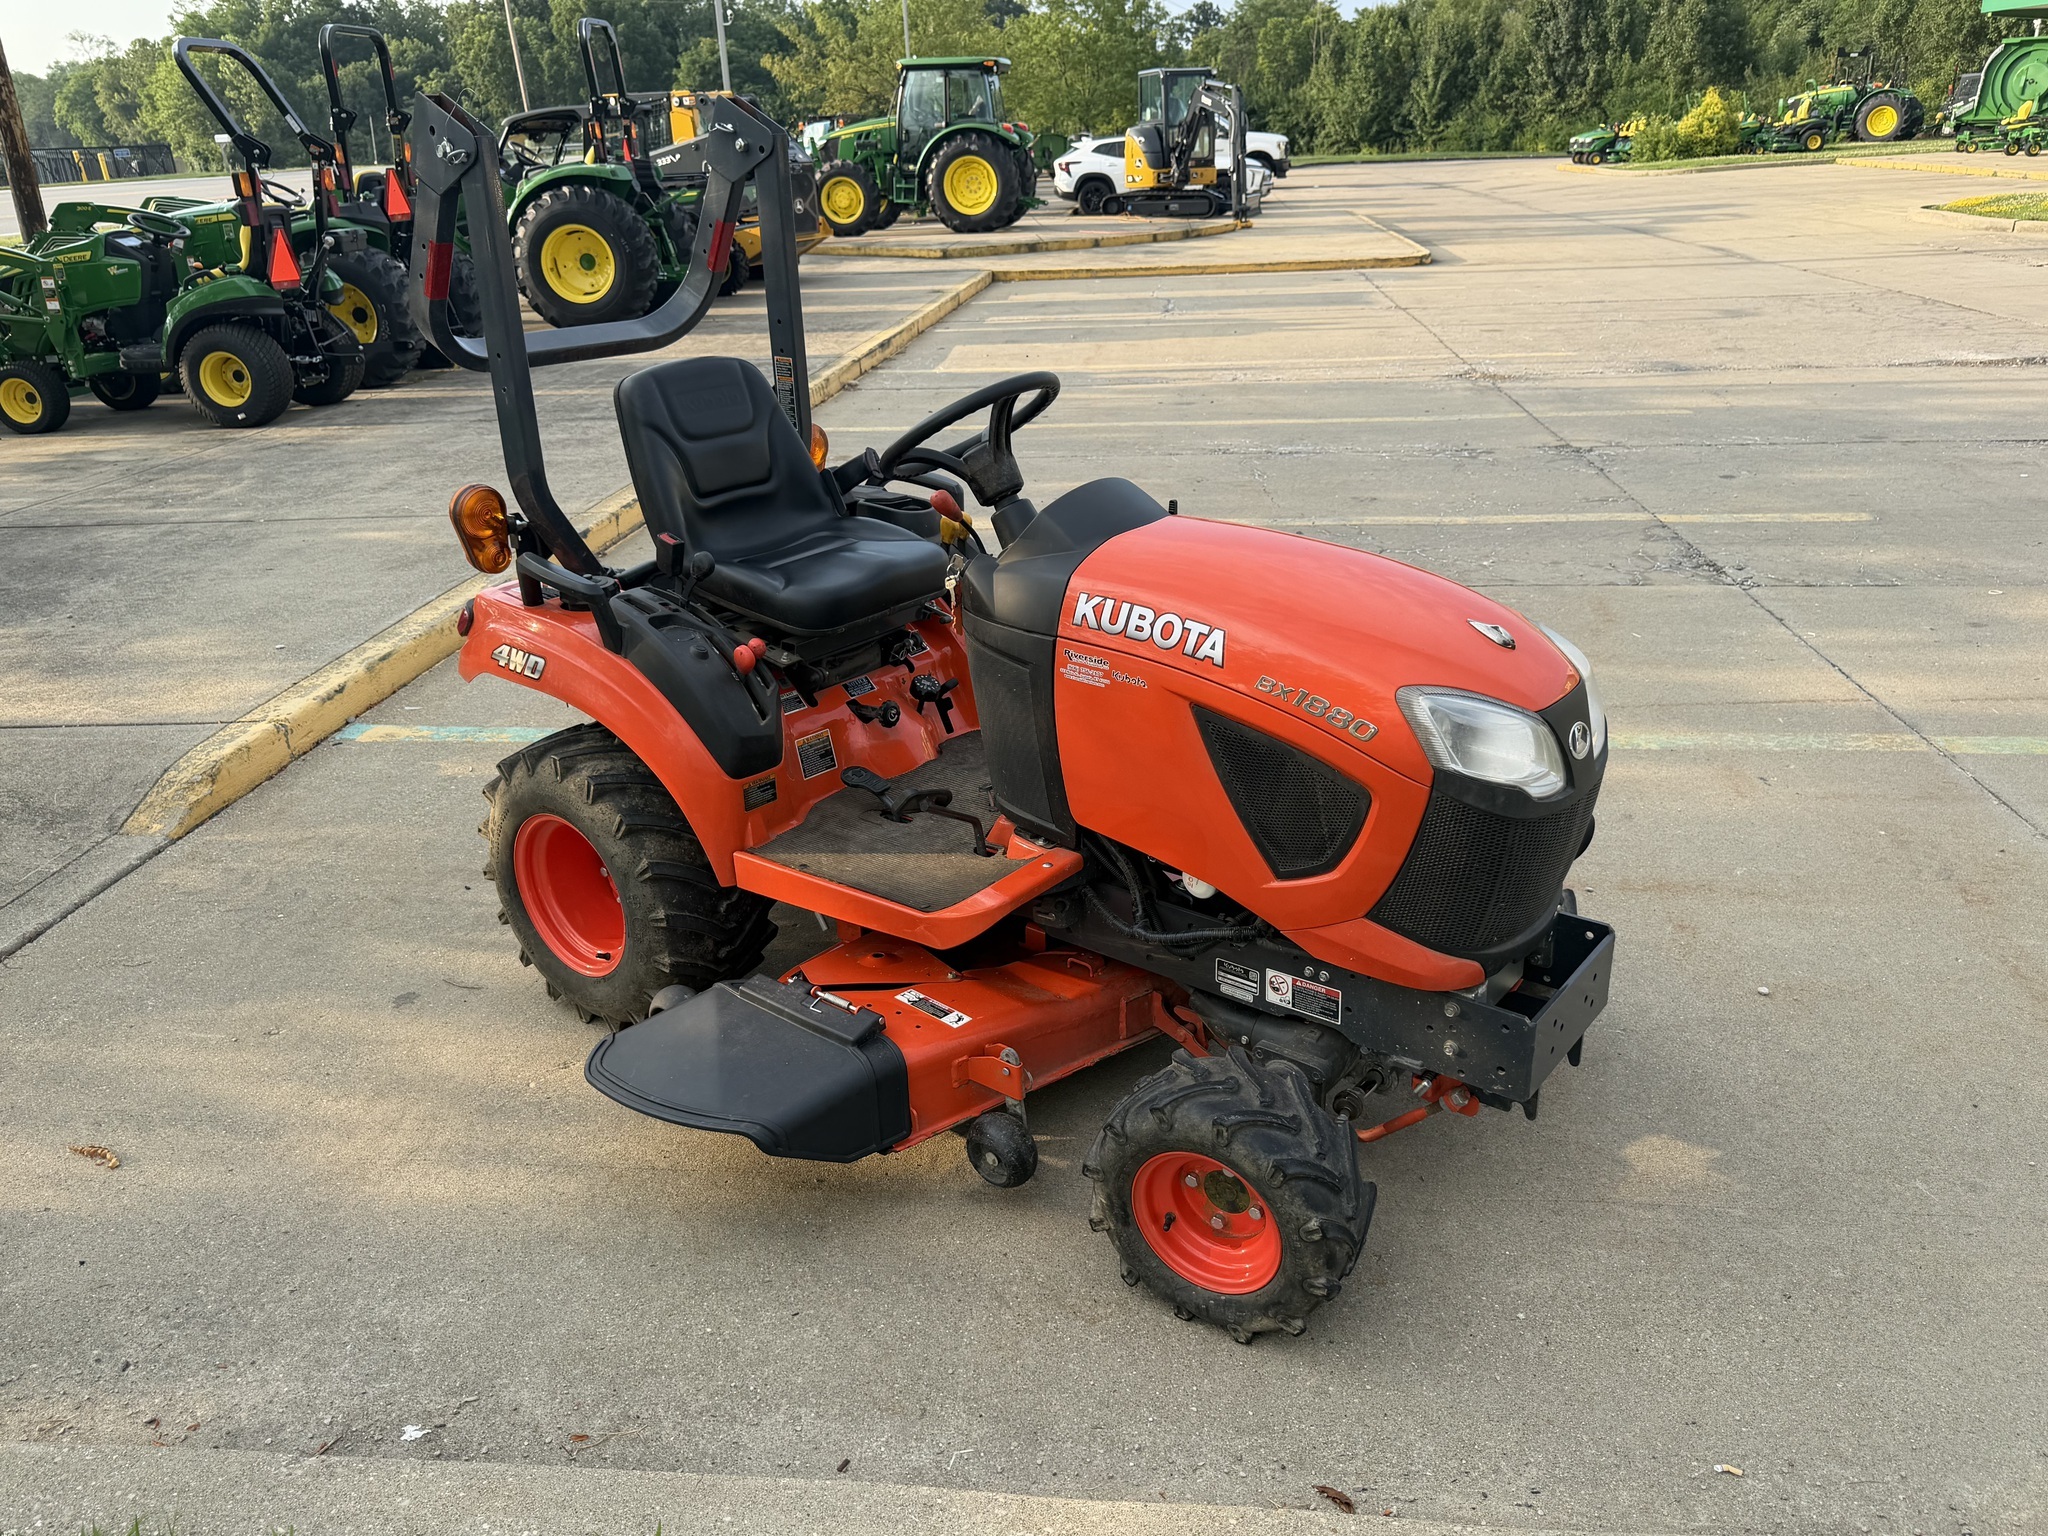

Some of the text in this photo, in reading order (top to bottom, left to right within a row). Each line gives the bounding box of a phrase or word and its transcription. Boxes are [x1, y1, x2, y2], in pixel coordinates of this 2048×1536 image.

[1072, 592, 1228, 668] KUBOTA
[491, 643, 546, 681] 4WD
[1063, 648, 1110, 667] Riverside
[1112, 670, 1148, 688] Kubota
[1253, 674, 1380, 743] BX1880
[1301, 981, 1326, 994] DANGER
